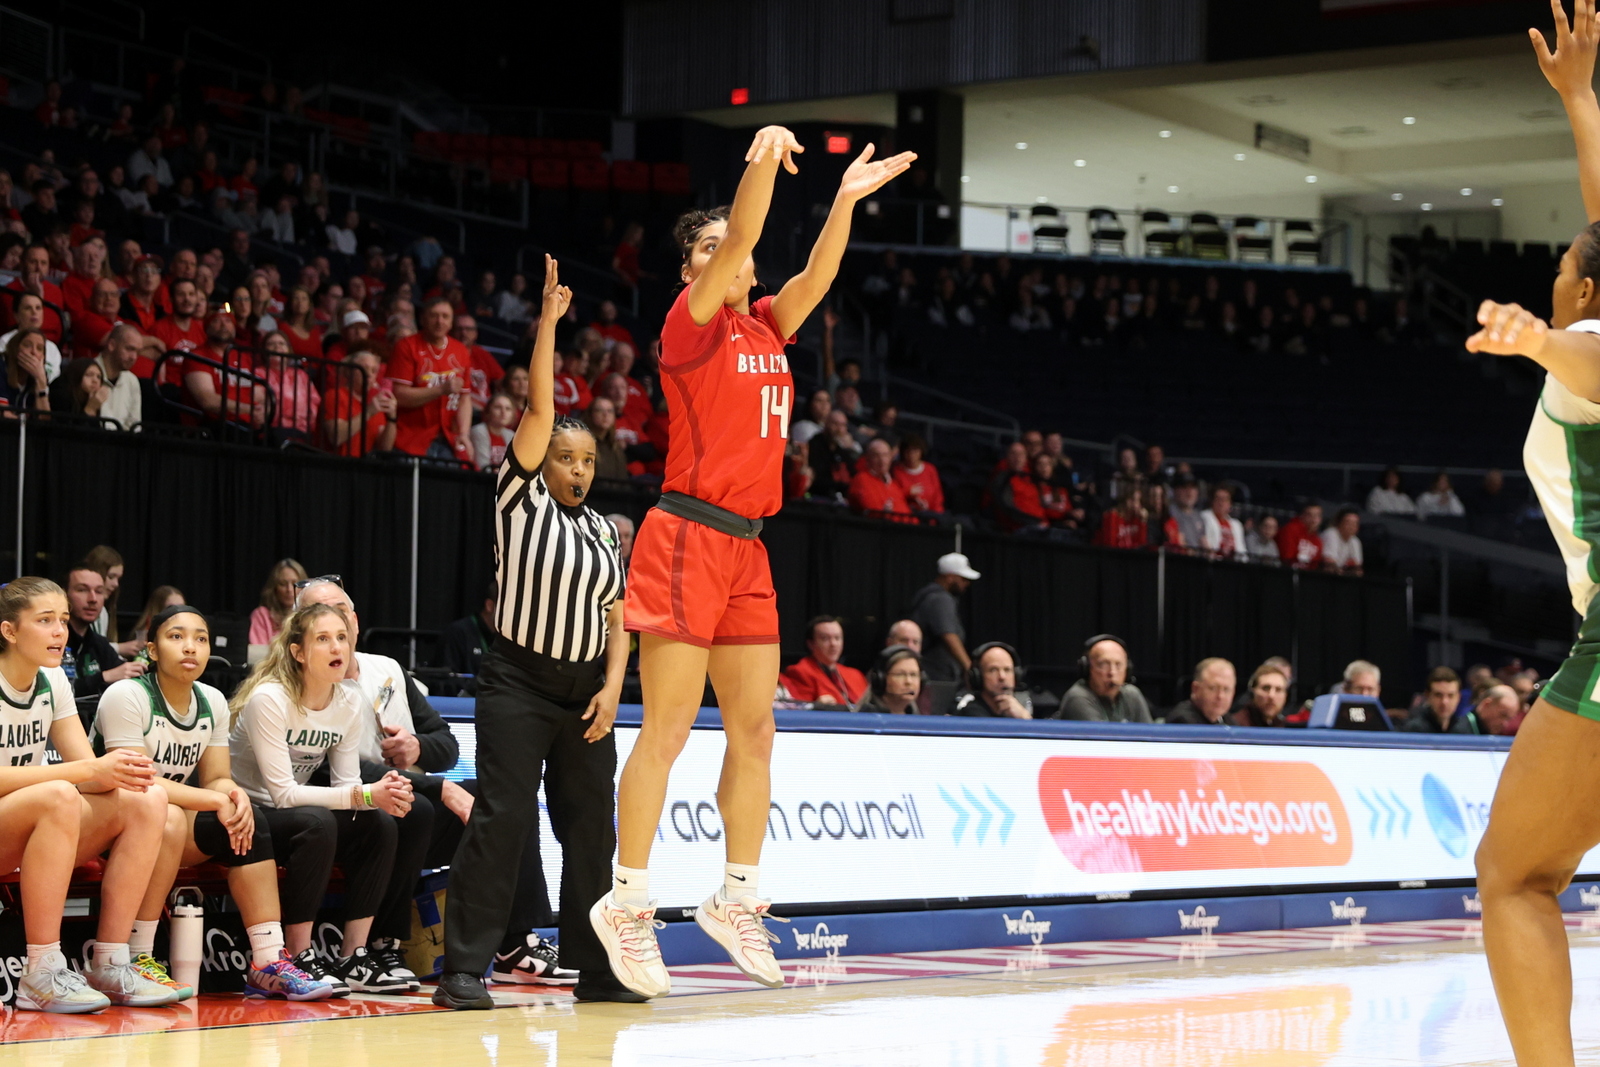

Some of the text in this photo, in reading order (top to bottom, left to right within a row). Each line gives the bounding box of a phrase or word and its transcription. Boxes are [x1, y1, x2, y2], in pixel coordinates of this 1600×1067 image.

[760, 385, 790, 439] 14
[798, 793, 924, 840] council
[1062, 788, 1338, 847] healthykidsgo.org
[811, 922, 848, 957] Kroger
